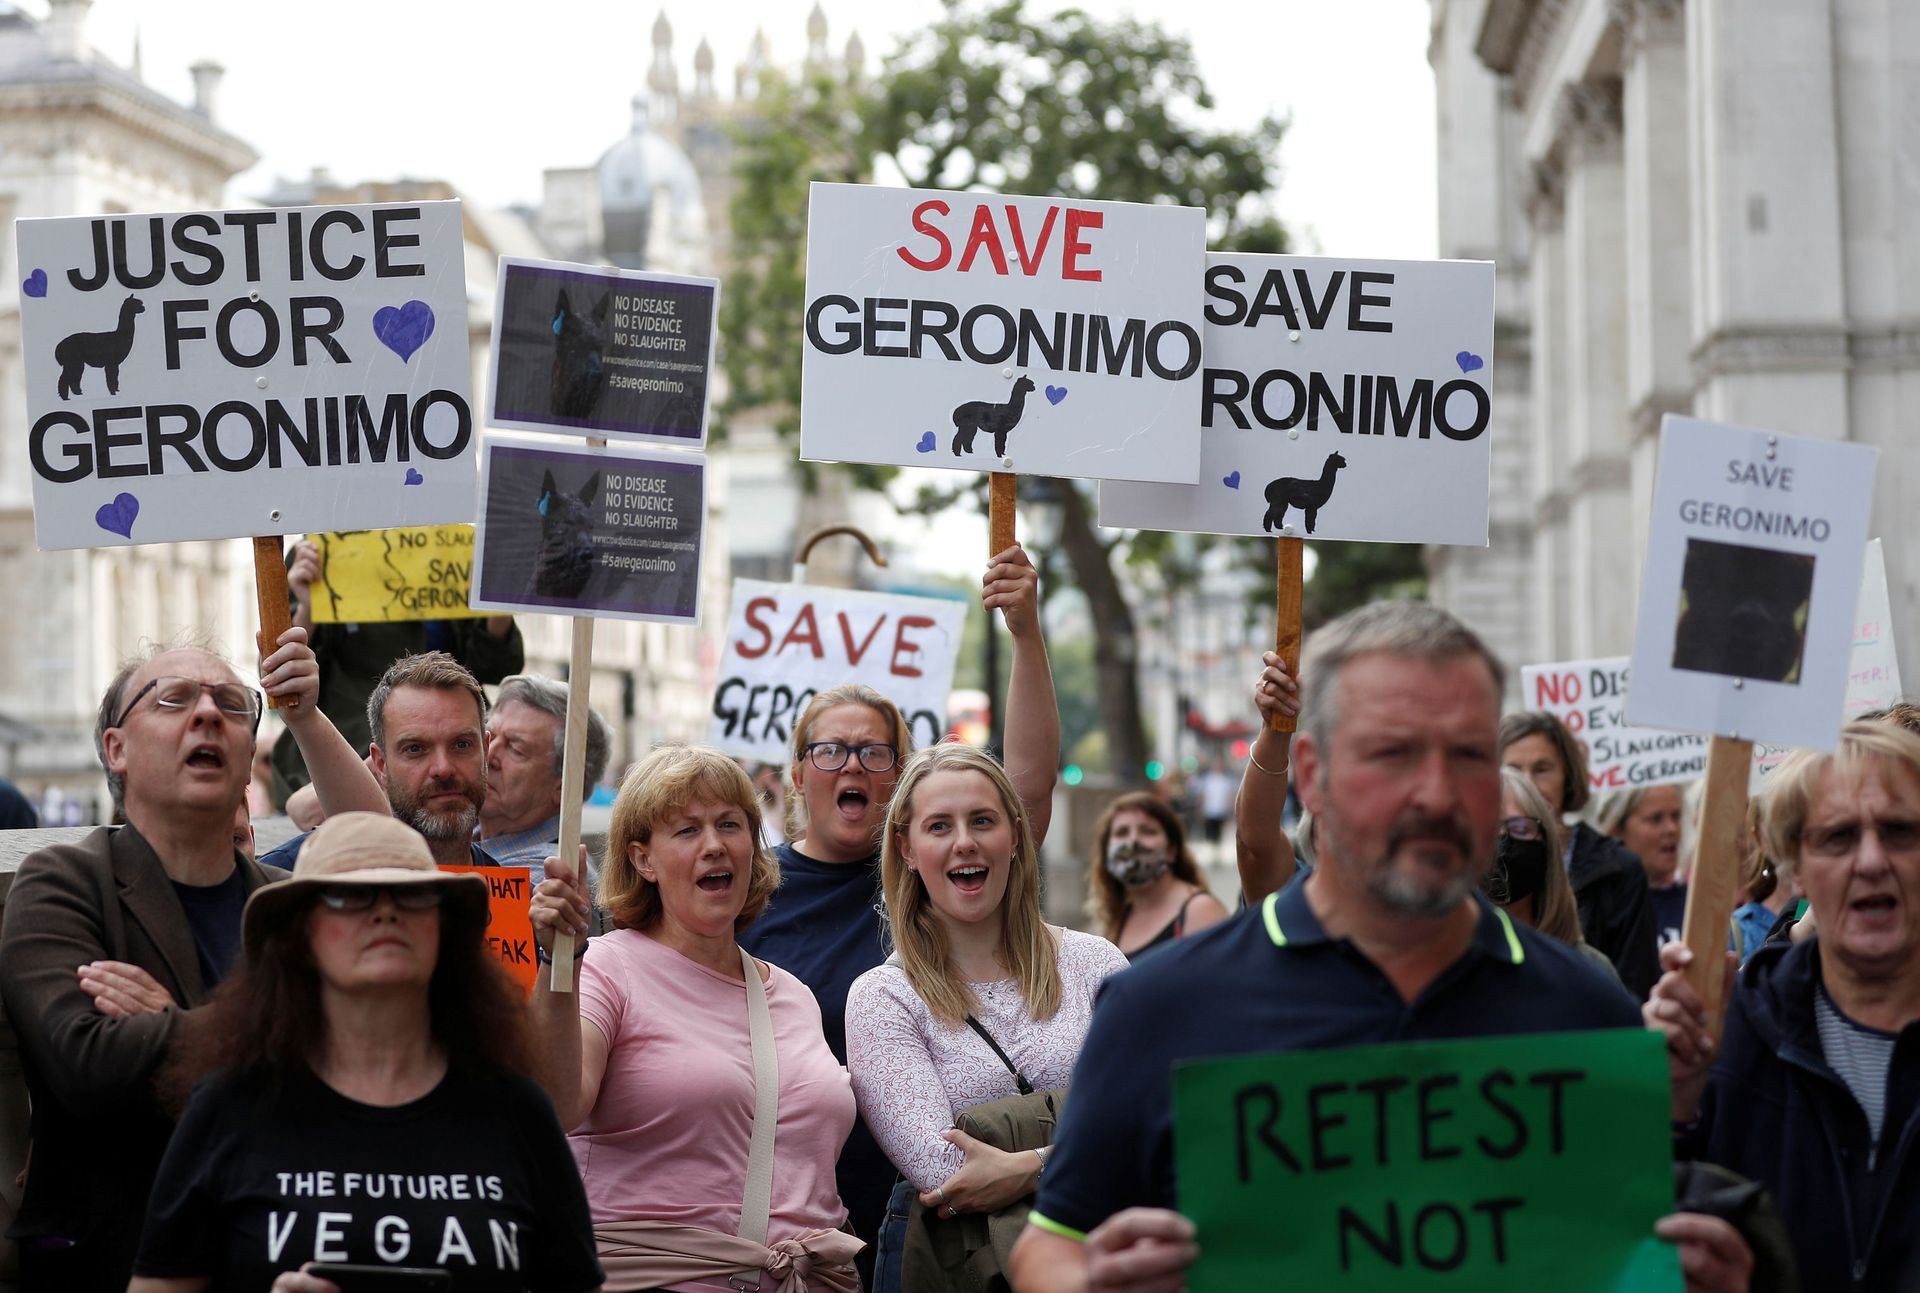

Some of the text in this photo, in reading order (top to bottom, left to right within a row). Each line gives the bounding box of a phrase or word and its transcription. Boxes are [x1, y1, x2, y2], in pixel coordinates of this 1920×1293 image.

[66, 207, 425, 292] JUSTICE
[897, 200, 1104, 282] SAVE
[615, 296, 676, 315] NO DISEASE
[1204, 264, 1395, 333] SAVE
[162, 295, 352, 371] FOR
[614, 313, 683, 333] NO EVIDENCE
[805, 294, 1201, 381] GERONIMO
[614, 332, 687, 352] NO SLAUGHTER
[609, 372, 684, 394] #savegeronimo
[29, 389, 472, 483] GERONIMO
[606, 474, 667, 494] NO DISEASE
[1726, 459, 1793, 492] SAVE
[605, 492, 674, 512] NO EVIDENCE
[605, 511, 678, 530] NO SLAUGHTER
[1679, 499, 1830, 543] GERONIMO
[400, 529, 475, 548] NO SLAU
[601, 552, 676, 573] #savegeronimo
[735, 597, 936, 678] SAVE
[1536, 672, 1581, 707] NO
[485, 875, 526, 900] HAT
[1233, 1067, 1588, 1184] RETEST
[276, 1171, 504, 1201] THE FUTURE IS
[267, 1211, 520, 1271] VEGAN
[1337, 1196, 1528, 1272] NOT
